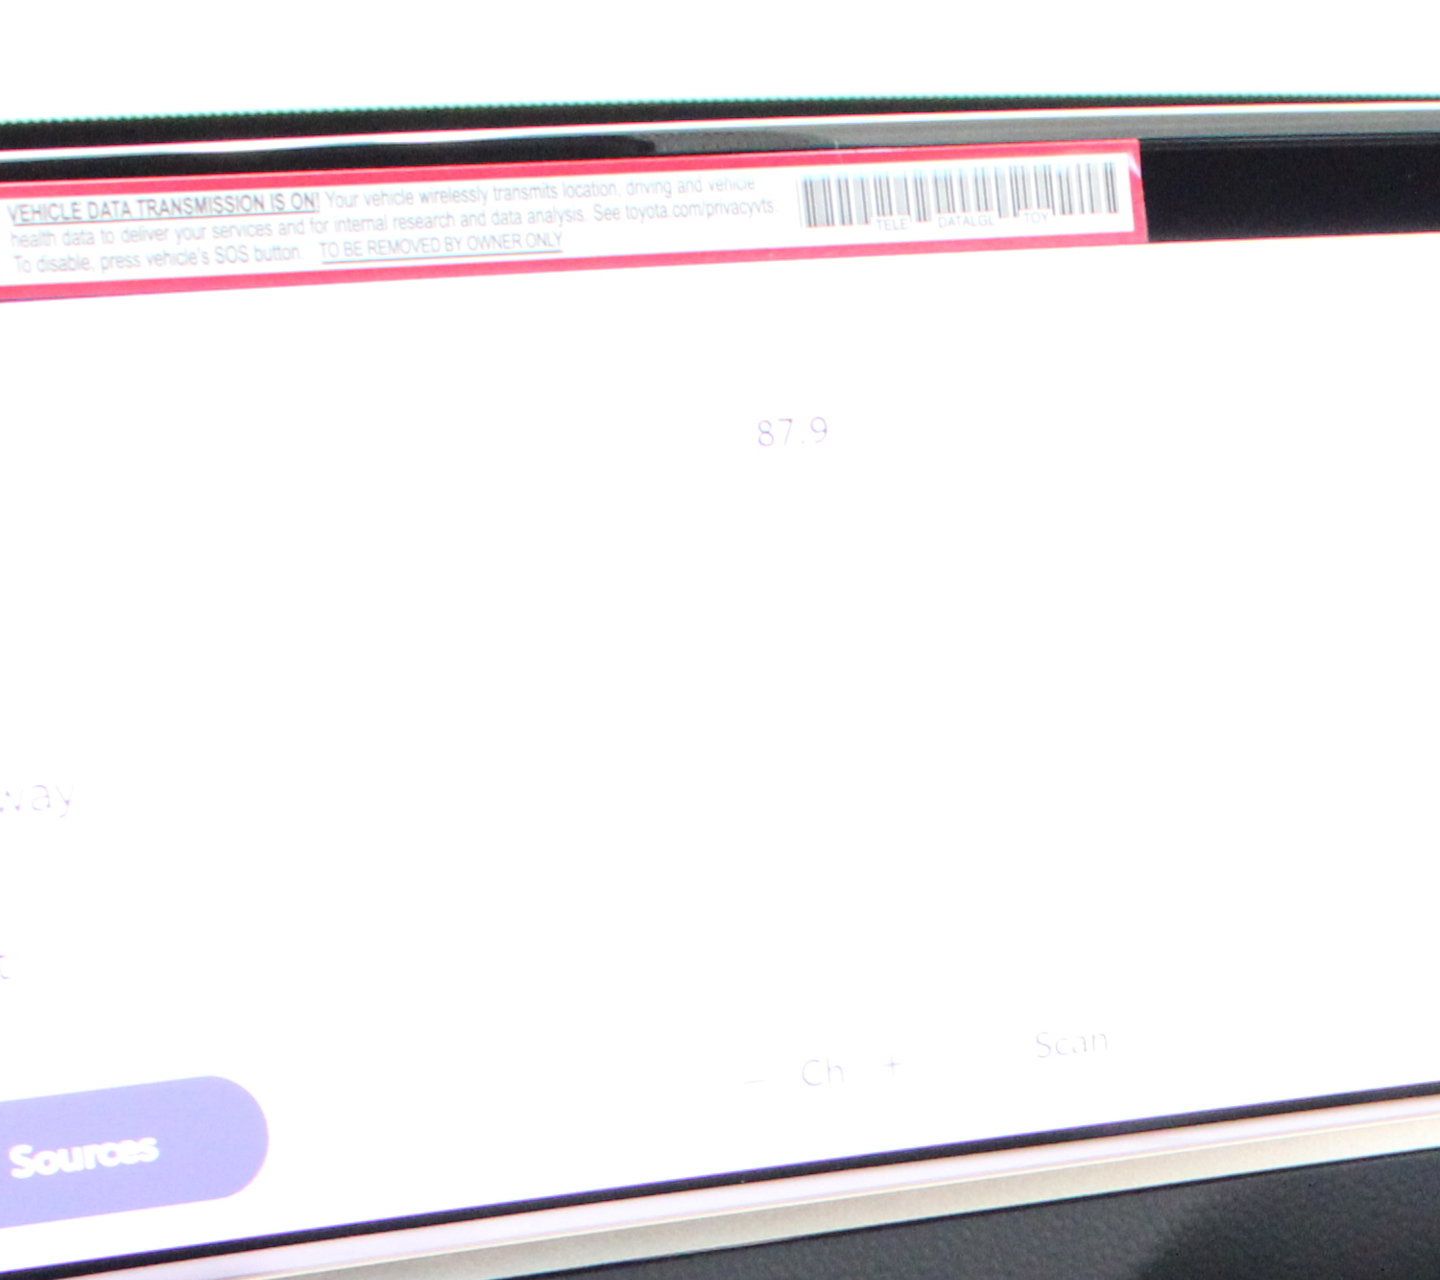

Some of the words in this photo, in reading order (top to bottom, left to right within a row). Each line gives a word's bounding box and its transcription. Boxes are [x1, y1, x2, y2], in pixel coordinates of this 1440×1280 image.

[7, 202, 81, 223] VEHICLE
[87, 199, 132, 219] DATA
[137, 194, 264, 217] TRANSMISSION
[271, 193, 284, 211] IS
[290, 192, 320, 211] ON!
[326, 190, 358, 208] Your
[364, 188, 414, 207] vehicle
[418, 185, 488, 206] wirelessly
[493, 183, 557, 201] transmits
[563, 181, 621, 199] location,
[626, 179, 672, 198] driving
[678, 178, 703, 194] and
[709, 177, 756, 193] vehicle
[876, 217, 908, 231] TELE
[1023, 211, 1049, 225] TOY
[10, 230, 55, 247] health
[63, 229, 96, 245] data
[101, 228, 115, 243] to
[121, 225, 168, 243] deliver
[175, 226, 207, 245] your
[212, 221, 273, 239] services
[279, 219, 304, 235] and
[310, 218, 328, 234] for
[334, 216, 387, 233] internal
[393, 213, 455, 230] research
[460, 211, 486, 227] and
[492, 210, 522, 226] data
[593, 203, 620, 221] See
[15, 256, 32, 273] To
[100, 253, 141, 274] press
[146, 248, 209, 267] vehicle's
[215, 244, 249, 263] SOS
[320, 241, 339, 258] TO
[344, 240, 364, 257] BE
[368, 237, 440, 255] REMOVED
[445, 235, 461, 253] BY
[467, 233, 522, 250] OWNER
[526, 231, 563, 247] ONLY
[755, 414, 831, 450] 87.9
[10, 1135, 160, 1179] Sources
